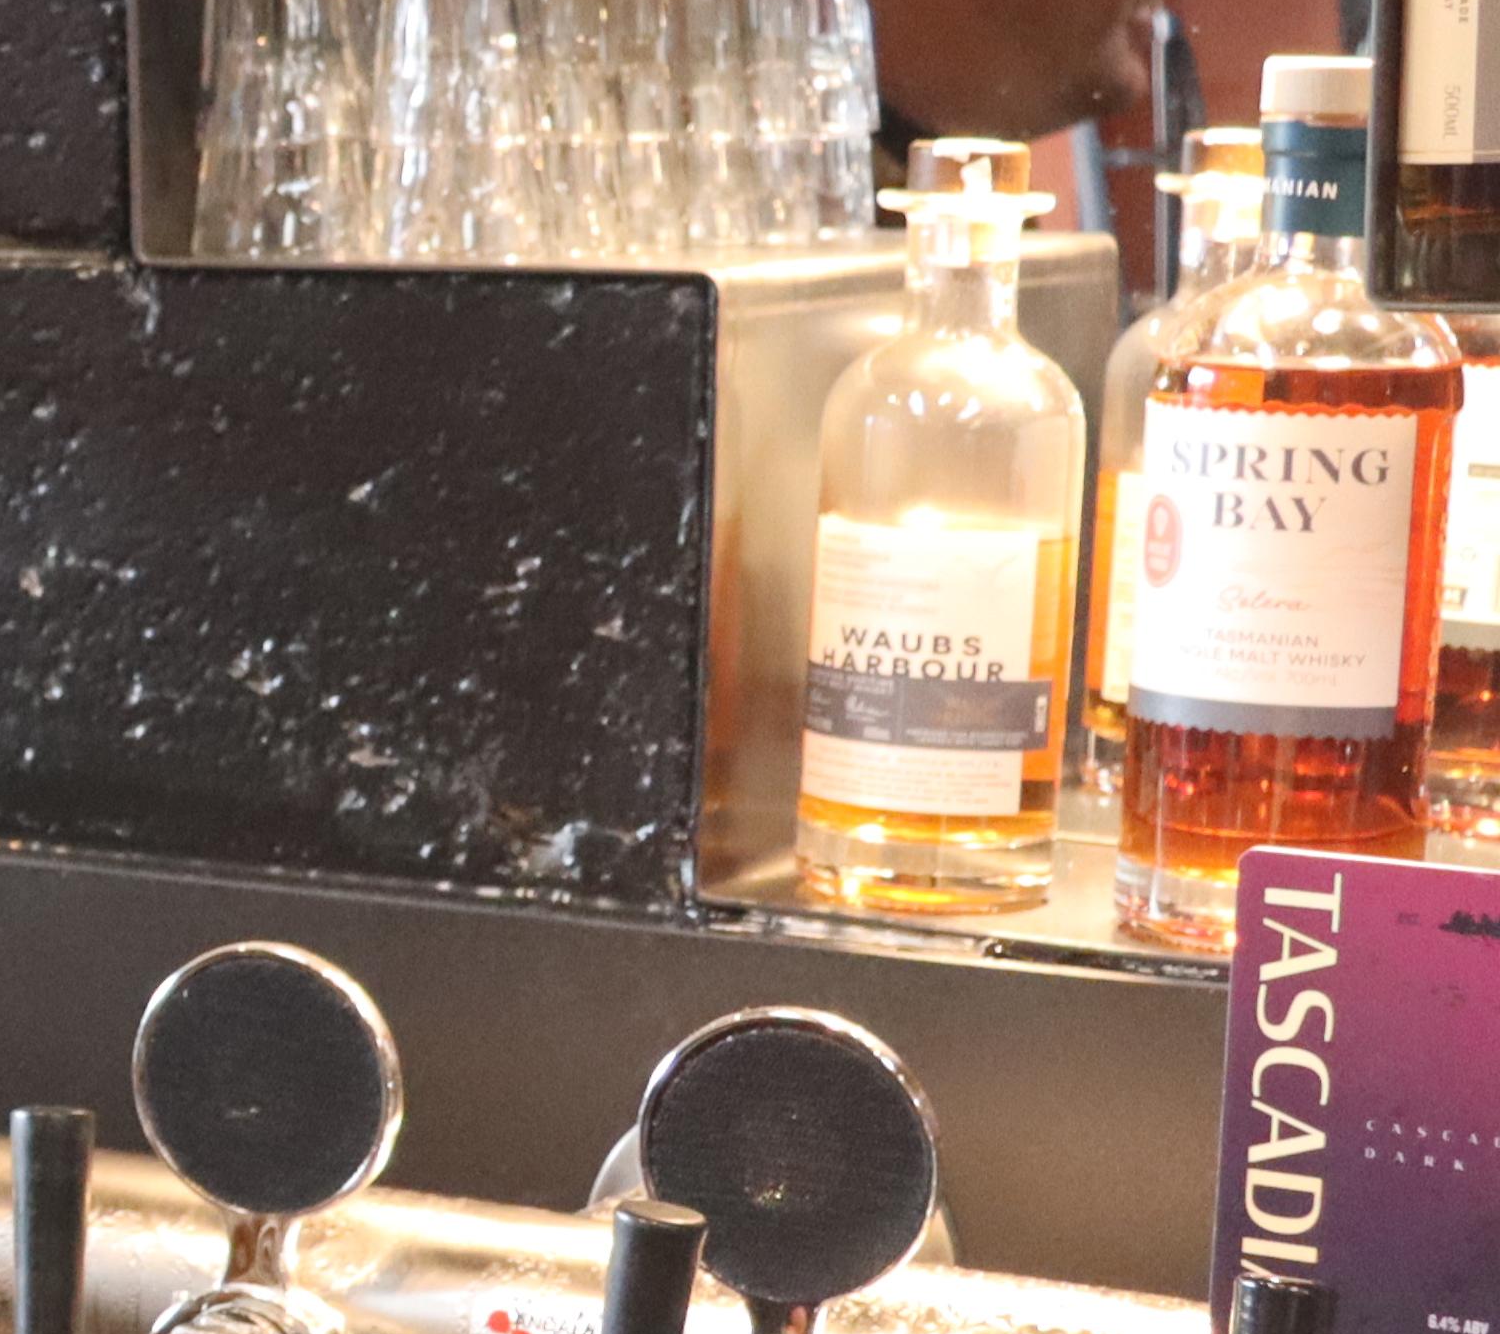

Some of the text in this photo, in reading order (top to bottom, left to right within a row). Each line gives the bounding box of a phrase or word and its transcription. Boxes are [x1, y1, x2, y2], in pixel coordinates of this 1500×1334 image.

[1172, 437, 1390, 487] SPRING
[1212, 490, 1328, 534] BAY
[840, 624, 984, 657] WAUBS
[1203, 627, 1320, 649] TASMANIAN
[821, 647, 1006, 683] HARBOUR
[1229, 646, 1280, 665] MALT
[1287, 649, 1368, 668] WHISKY
[1240, 871, 1343, 1281] TASCADI
[1363, 1146, 1465, 1172] DARK
